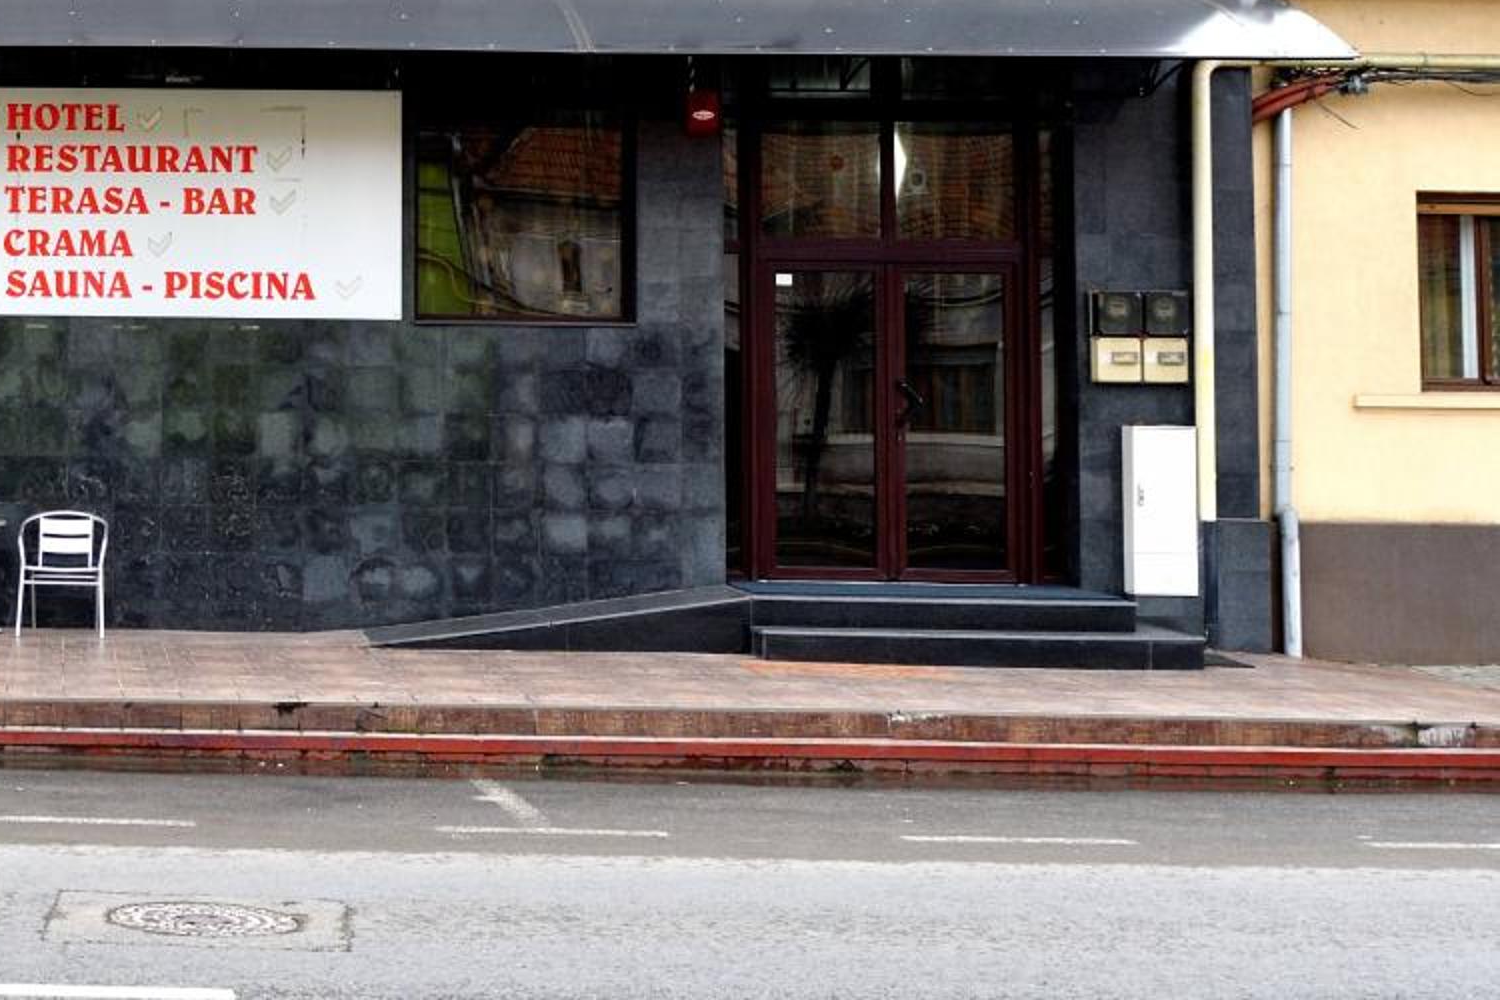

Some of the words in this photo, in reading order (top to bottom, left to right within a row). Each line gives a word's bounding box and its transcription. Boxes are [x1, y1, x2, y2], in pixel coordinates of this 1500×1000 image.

[6, 102, 126, 132] HOTEL
[6, 144, 258, 174] RESTAURANT
[5, 186, 150, 215] TERASA
[182, 187, 257, 216] BAR
[3, 228, 134, 258] CRAMA
[6, 270, 132, 300] SAUNA
[164, 271, 316, 301] PISCINA
